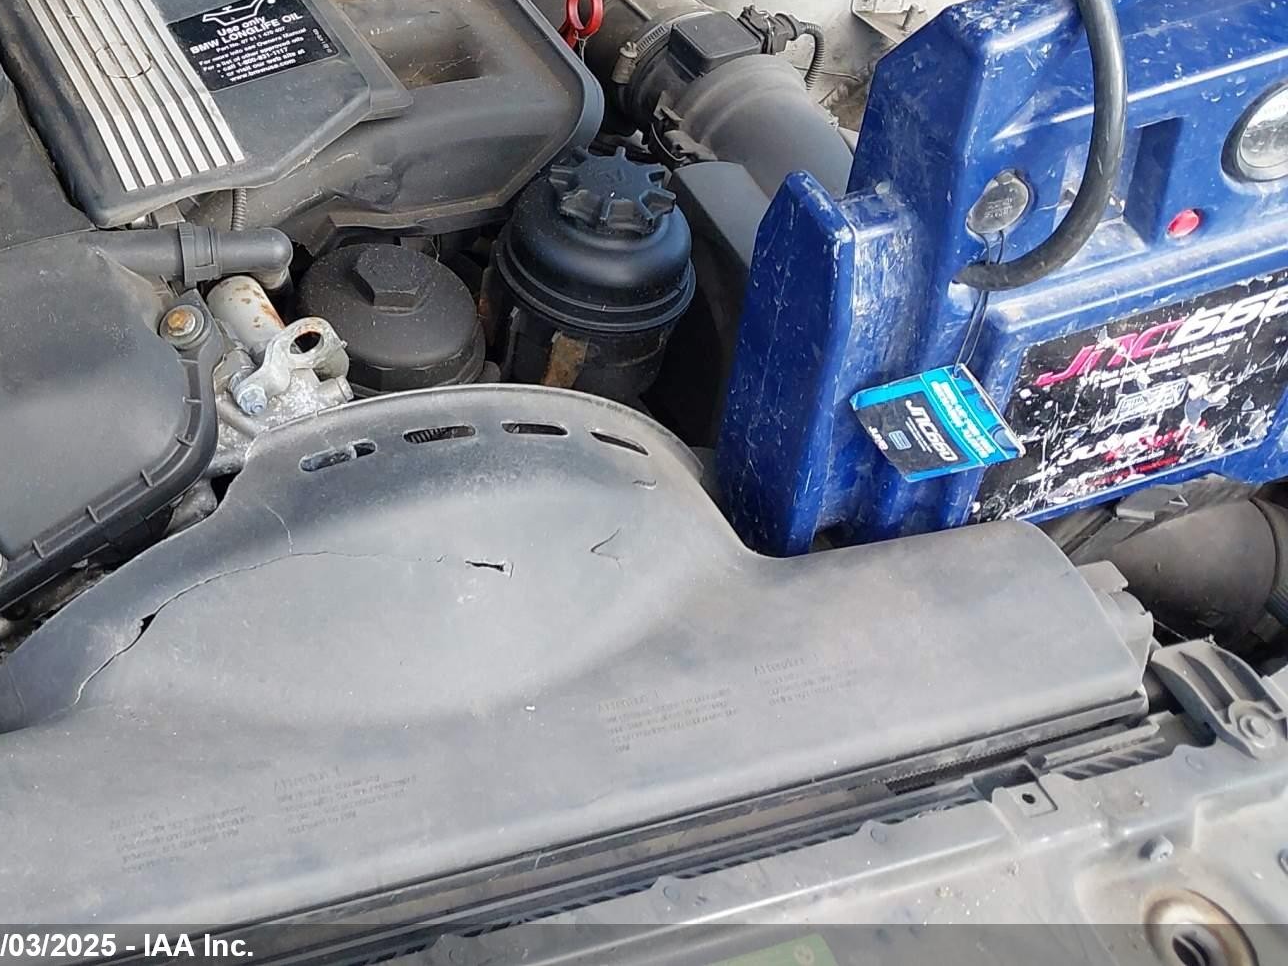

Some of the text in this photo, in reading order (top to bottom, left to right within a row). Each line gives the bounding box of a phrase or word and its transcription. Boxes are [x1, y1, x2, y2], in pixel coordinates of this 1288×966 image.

[190, 13, 303, 54] BMW LONGLIFE OIL
[217, 16, 266, 36] Use only
[905, 400, 958, 462] JNC660
